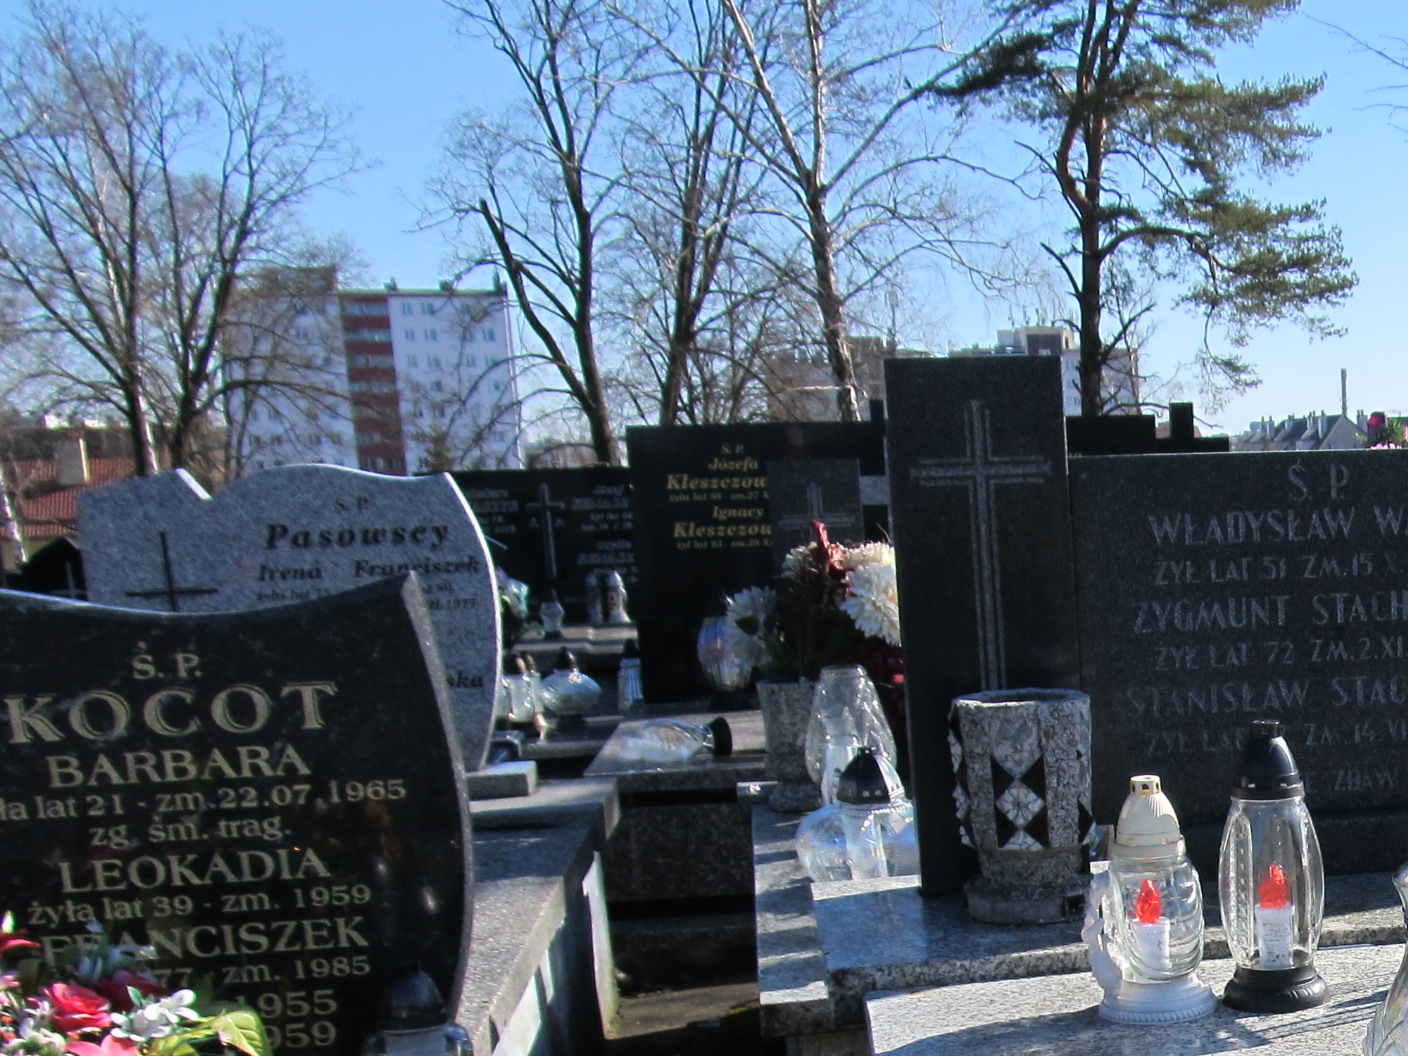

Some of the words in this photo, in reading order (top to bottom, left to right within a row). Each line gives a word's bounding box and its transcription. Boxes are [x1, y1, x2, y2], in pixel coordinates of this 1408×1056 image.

[708, 457, 759, 471] Józefa
[712, 505, 764, 520] Ignacy
[1148, 506, 1356, 546] WŁADYSŁAW
[264, 523, 449, 550] Pasowscy
[1134, 594, 1290, 634] ZYGMUNT
[177, 653, 202, 678] P.
[1265, 640, 1293, 665] 72
[3, 681, 340, 745] KOCOT
[1126, 679, 1310, 718] STANISŁAW
[46, 744, 312, 789] BARBARA
[34, 794, 78, 819] lat
[85, 793, 125, 816] 21
[217, 815, 292, 842] trag.
[57, 848, 332, 894] LEOKADIA
[27, 901, 95, 928] żyła
[102, 898, 142, 920] lat
[153, 895, 194, 917] 39
[222, 890, 281, 913] zm.
[295, 884, 372, 909] 1959
[222, 963, 281, 985] zm.
[294, 955, 371, 980] 1985
[265, 1020, 337, 1050] 959
